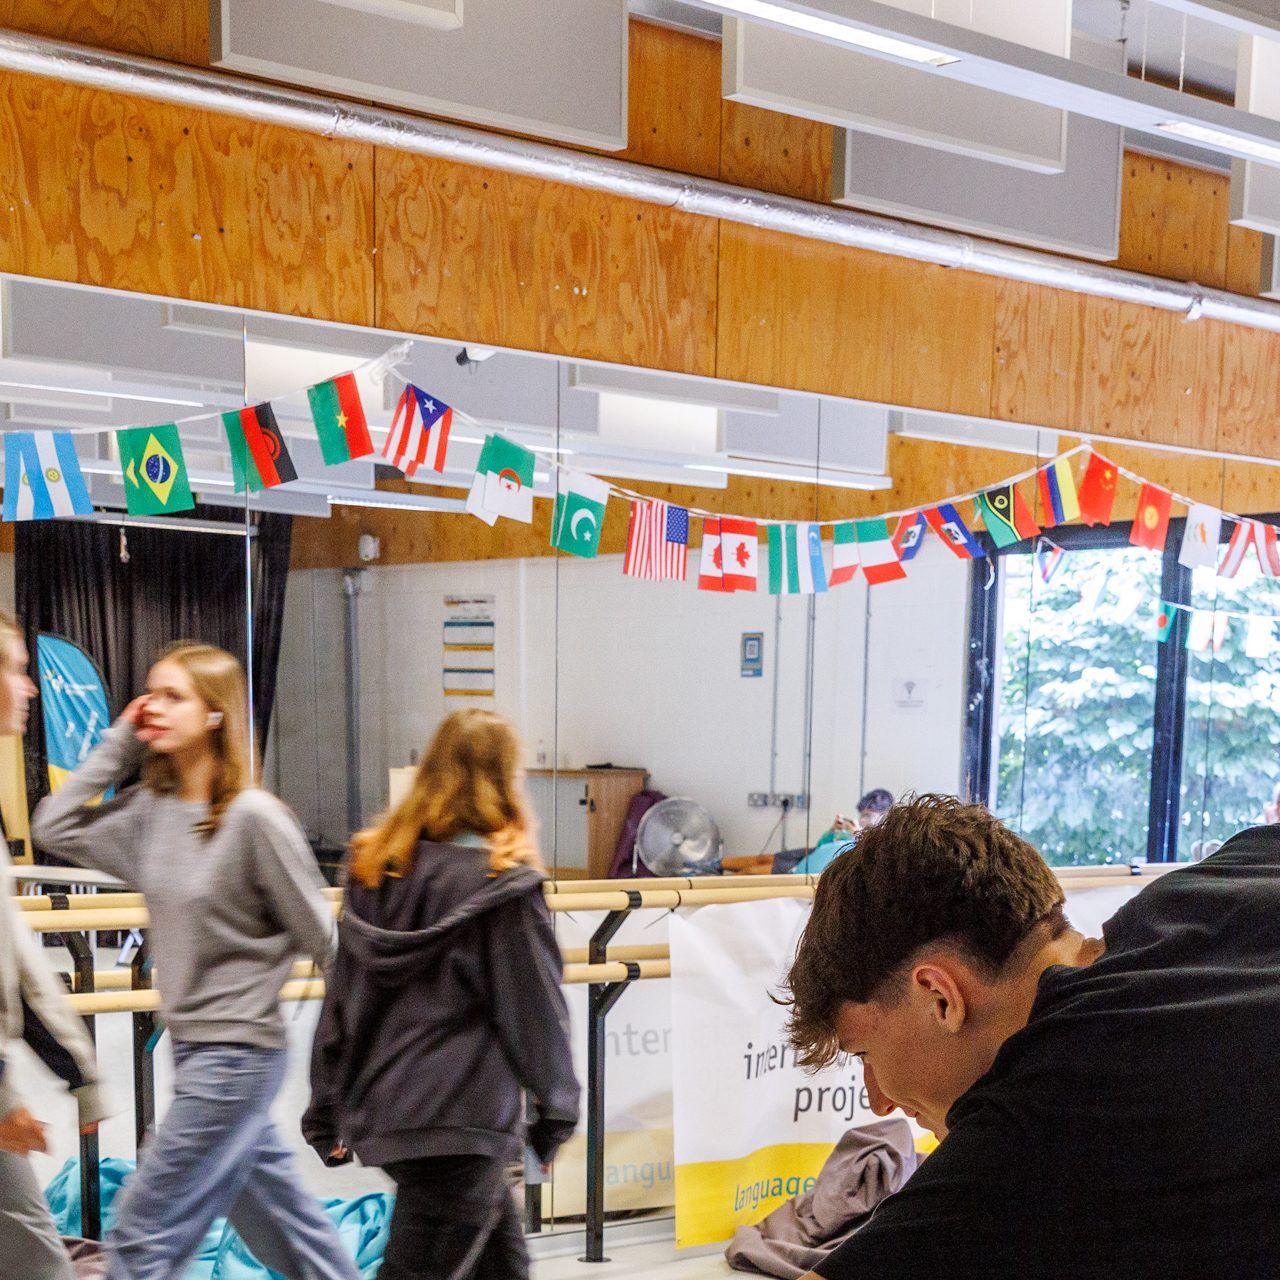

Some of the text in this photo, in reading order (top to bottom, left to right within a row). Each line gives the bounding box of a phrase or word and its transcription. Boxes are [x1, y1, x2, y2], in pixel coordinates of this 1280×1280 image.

[605, 1022, 672, 1058] nter
[793, 1074, 871, 1122] proje
[606, 1160, 673, 1189] angu
